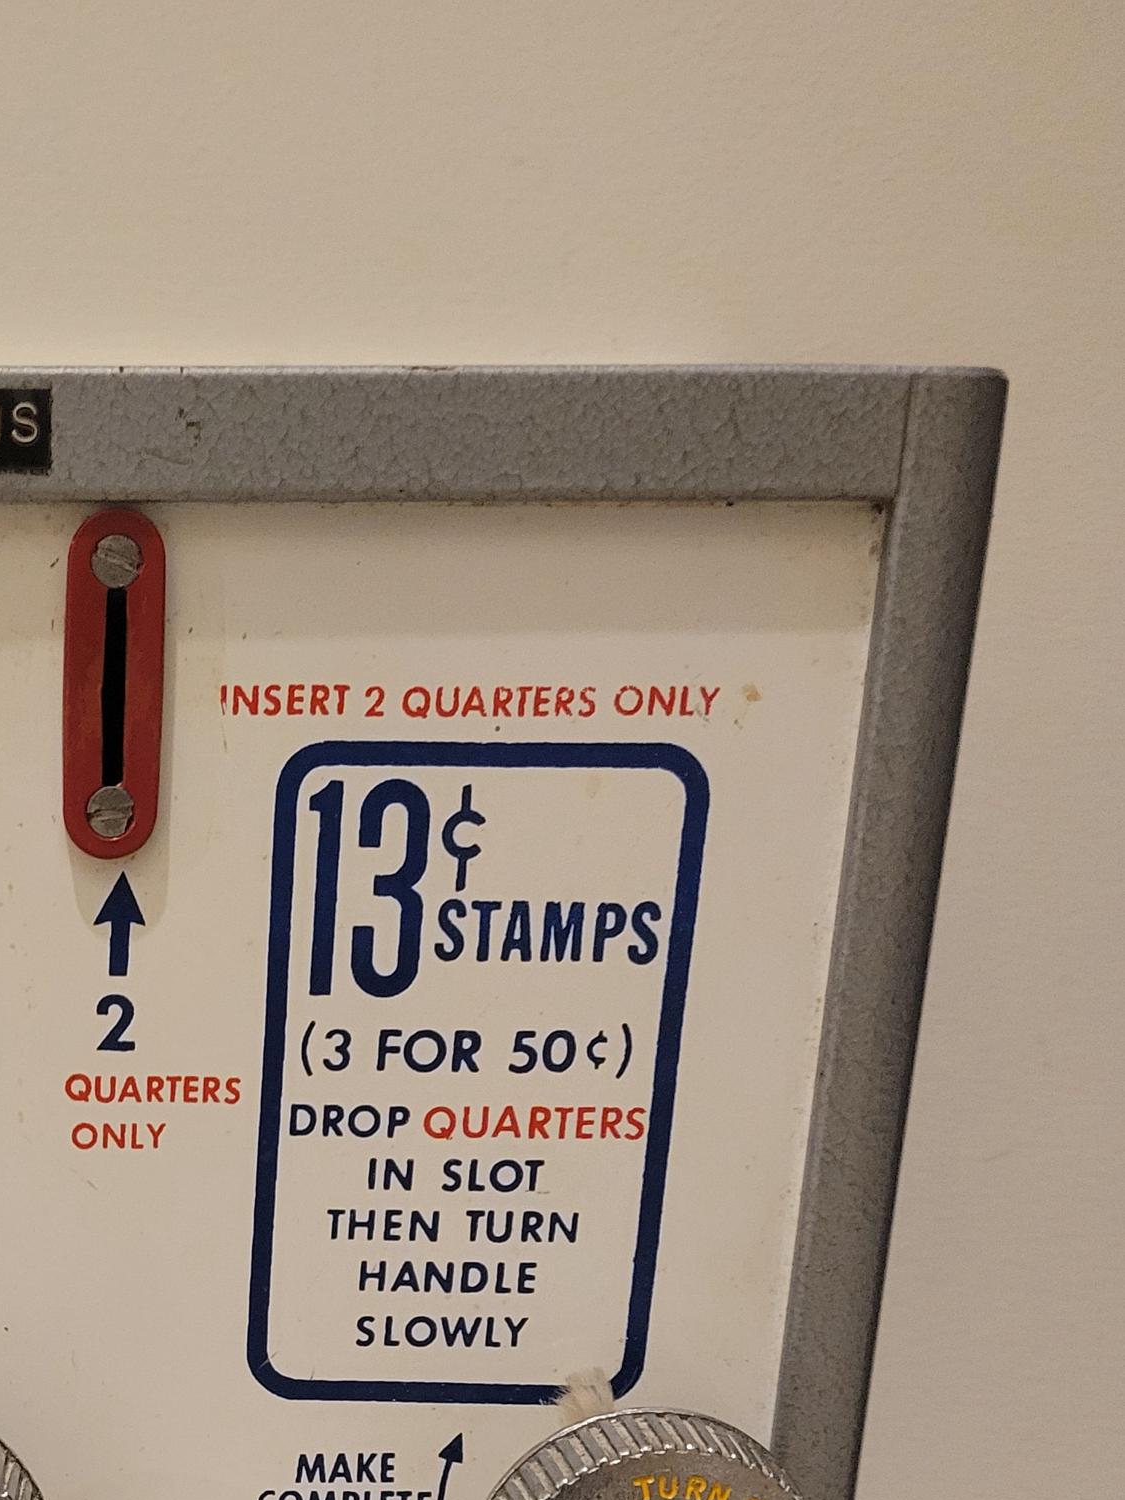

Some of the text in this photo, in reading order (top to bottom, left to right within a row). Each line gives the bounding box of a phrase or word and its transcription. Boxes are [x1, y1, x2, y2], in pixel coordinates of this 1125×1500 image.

[221, 684, 720, 719] INSERT 2 QUARTERS ONLY
[434, 899, 661, 965] STAMPS
[96, 994, 135, 1052] 2
[301, 1021, 351, 1076] (3
[376, 1029, 481, 1073] FOR
[65, 1074, 241, 1104] QUARTERS
[72, 1123, 166, 1149] ONLY
[289, 1104, 647, 1142] DROP QUARTERS
[368, 1158, 545, 1192] IN SLOT
[327, 1209, 579, 1243] THEN TURN
[359, 1261, 537, 1294] HANDLE
[356, 1316, 529, 1347] SLOWLY
[295, 1453, 395, 1483] MAKE
